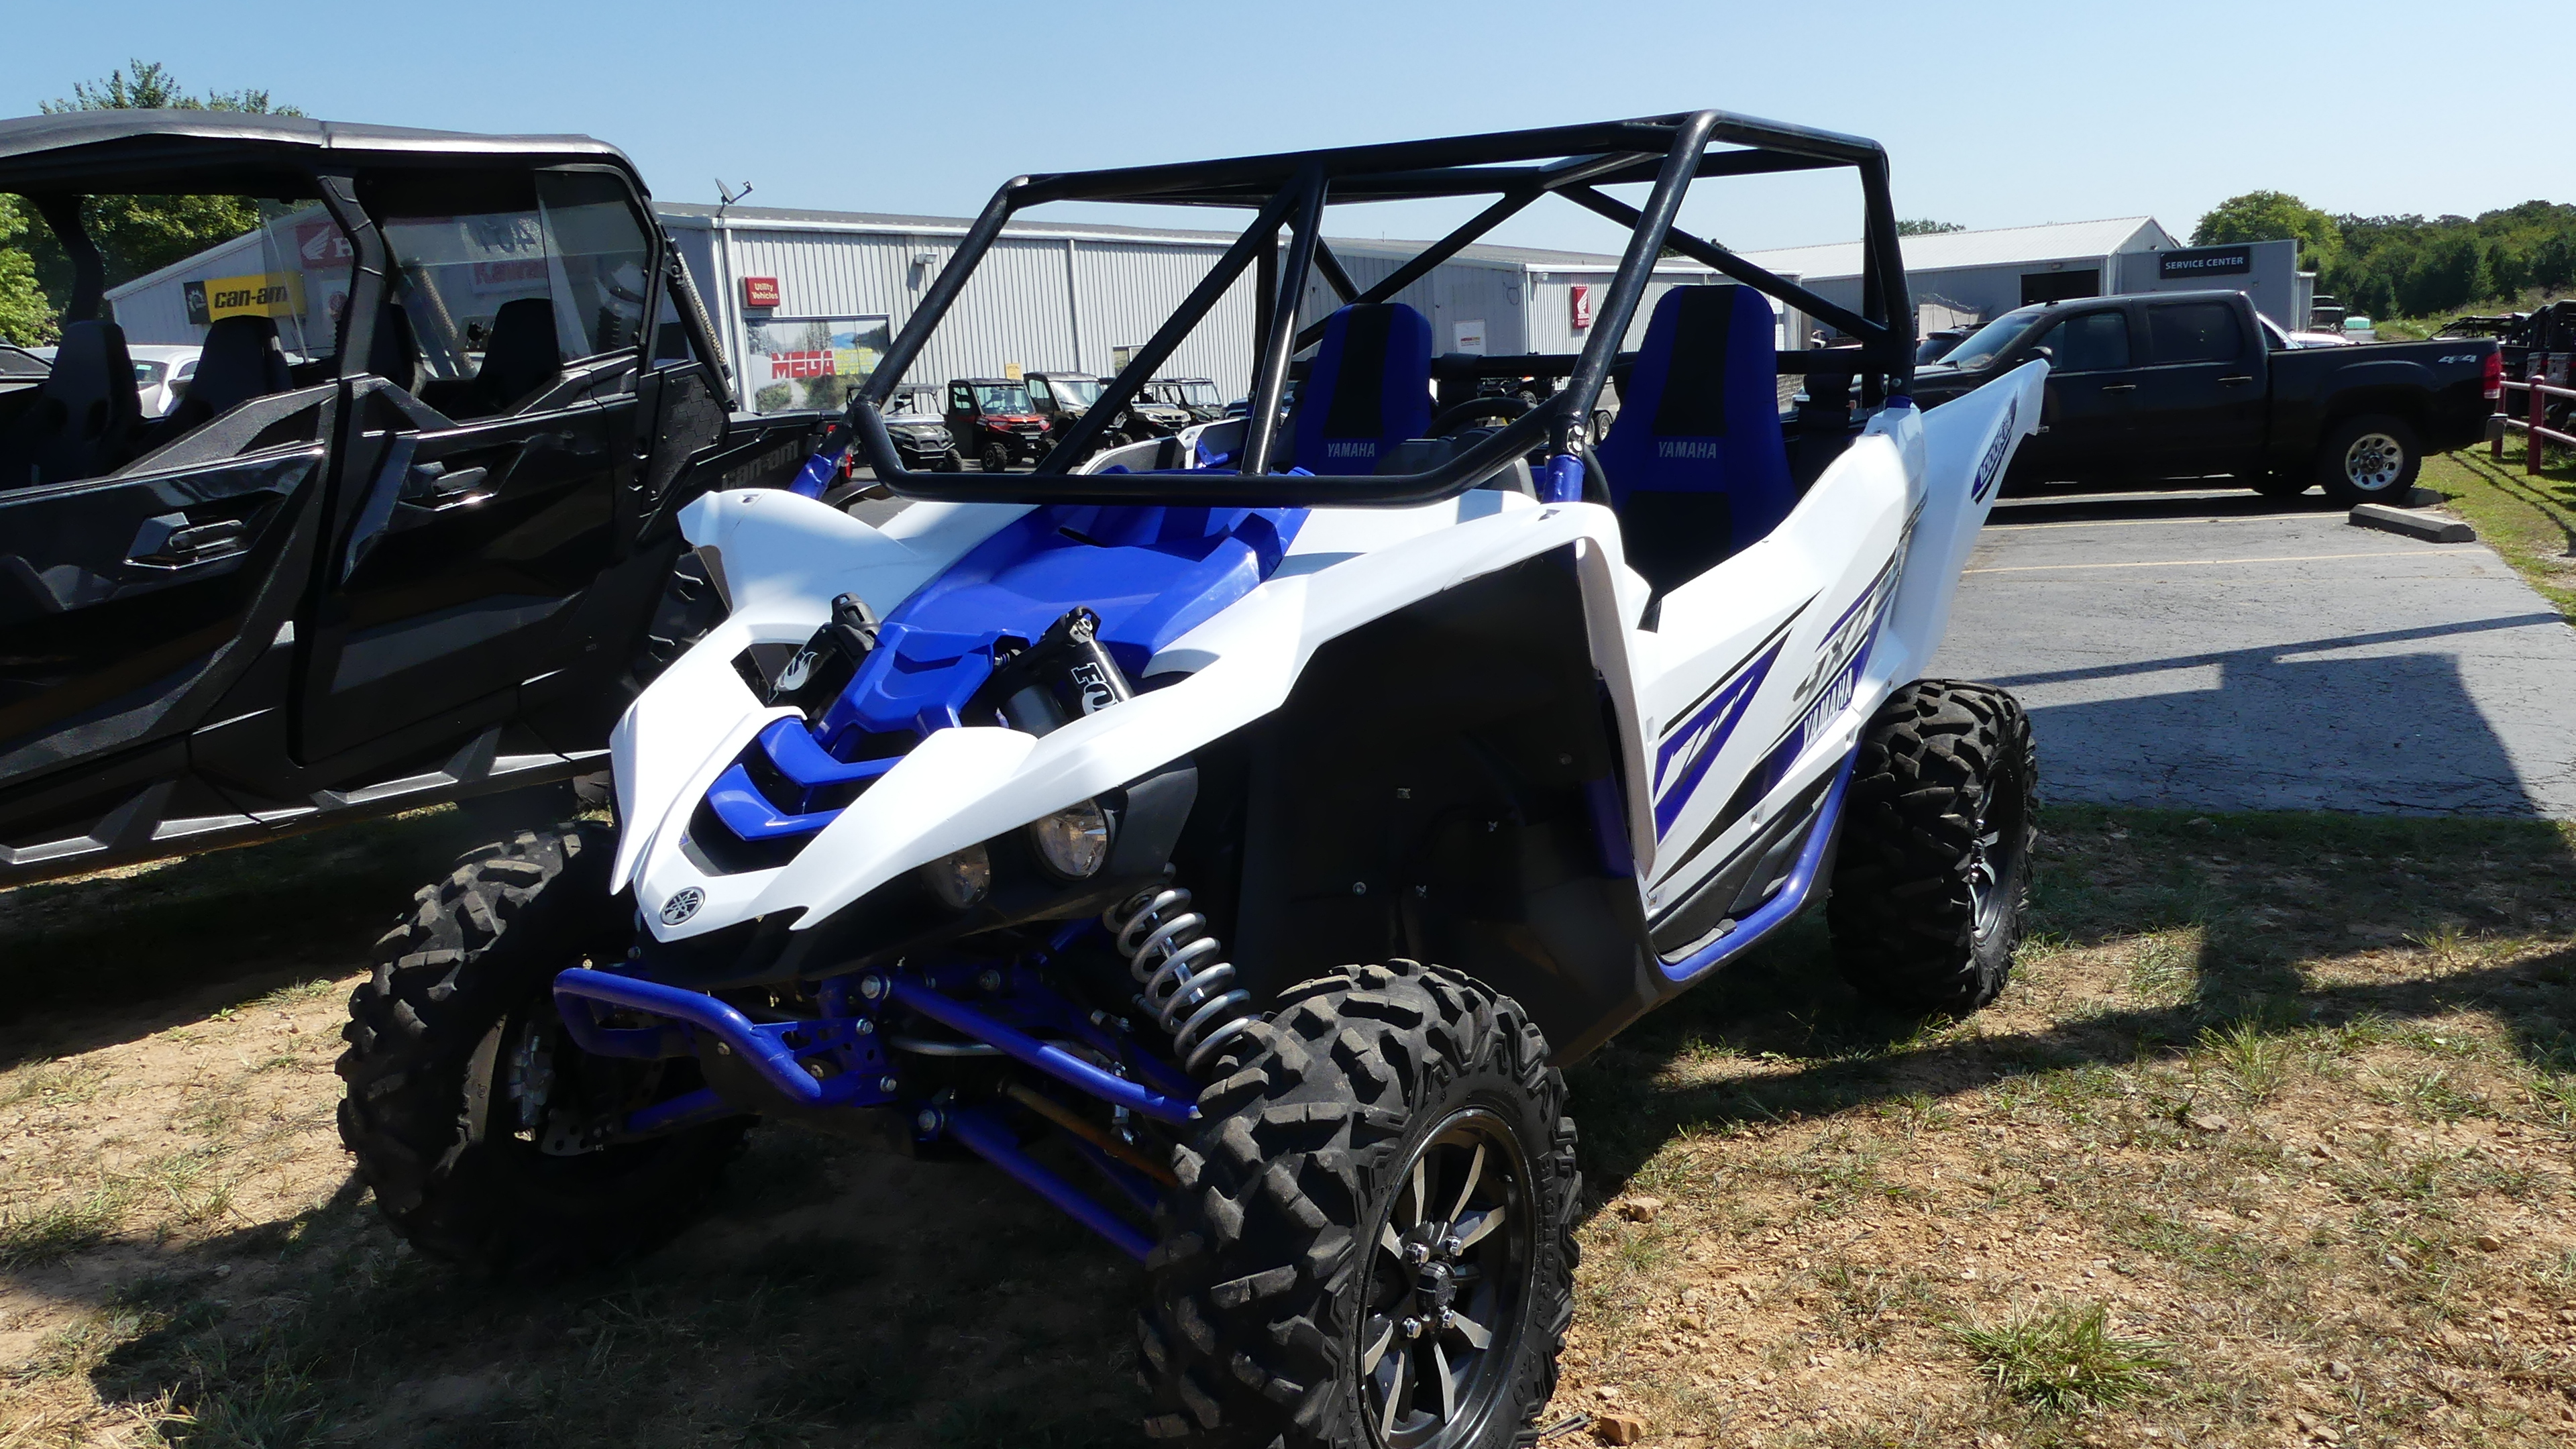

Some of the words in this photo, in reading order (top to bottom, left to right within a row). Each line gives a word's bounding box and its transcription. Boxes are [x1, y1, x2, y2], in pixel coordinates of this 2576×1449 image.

[2165, 259, 2204, 270] SERVICE
[2206, 257, 2244, 267] CENTER
[754, 282, 773, 292] Utility
[214, 286, 288, 309] can-am
[771, 350, 836, 379] MEGA
[1328, 442, 1375, 458] YAMAHA
[1658, 441, 1717, 459] YAMAHA
[1071, 662, 1120, 716] FO
[1803, 667, 1854, 747] YAMAHA
